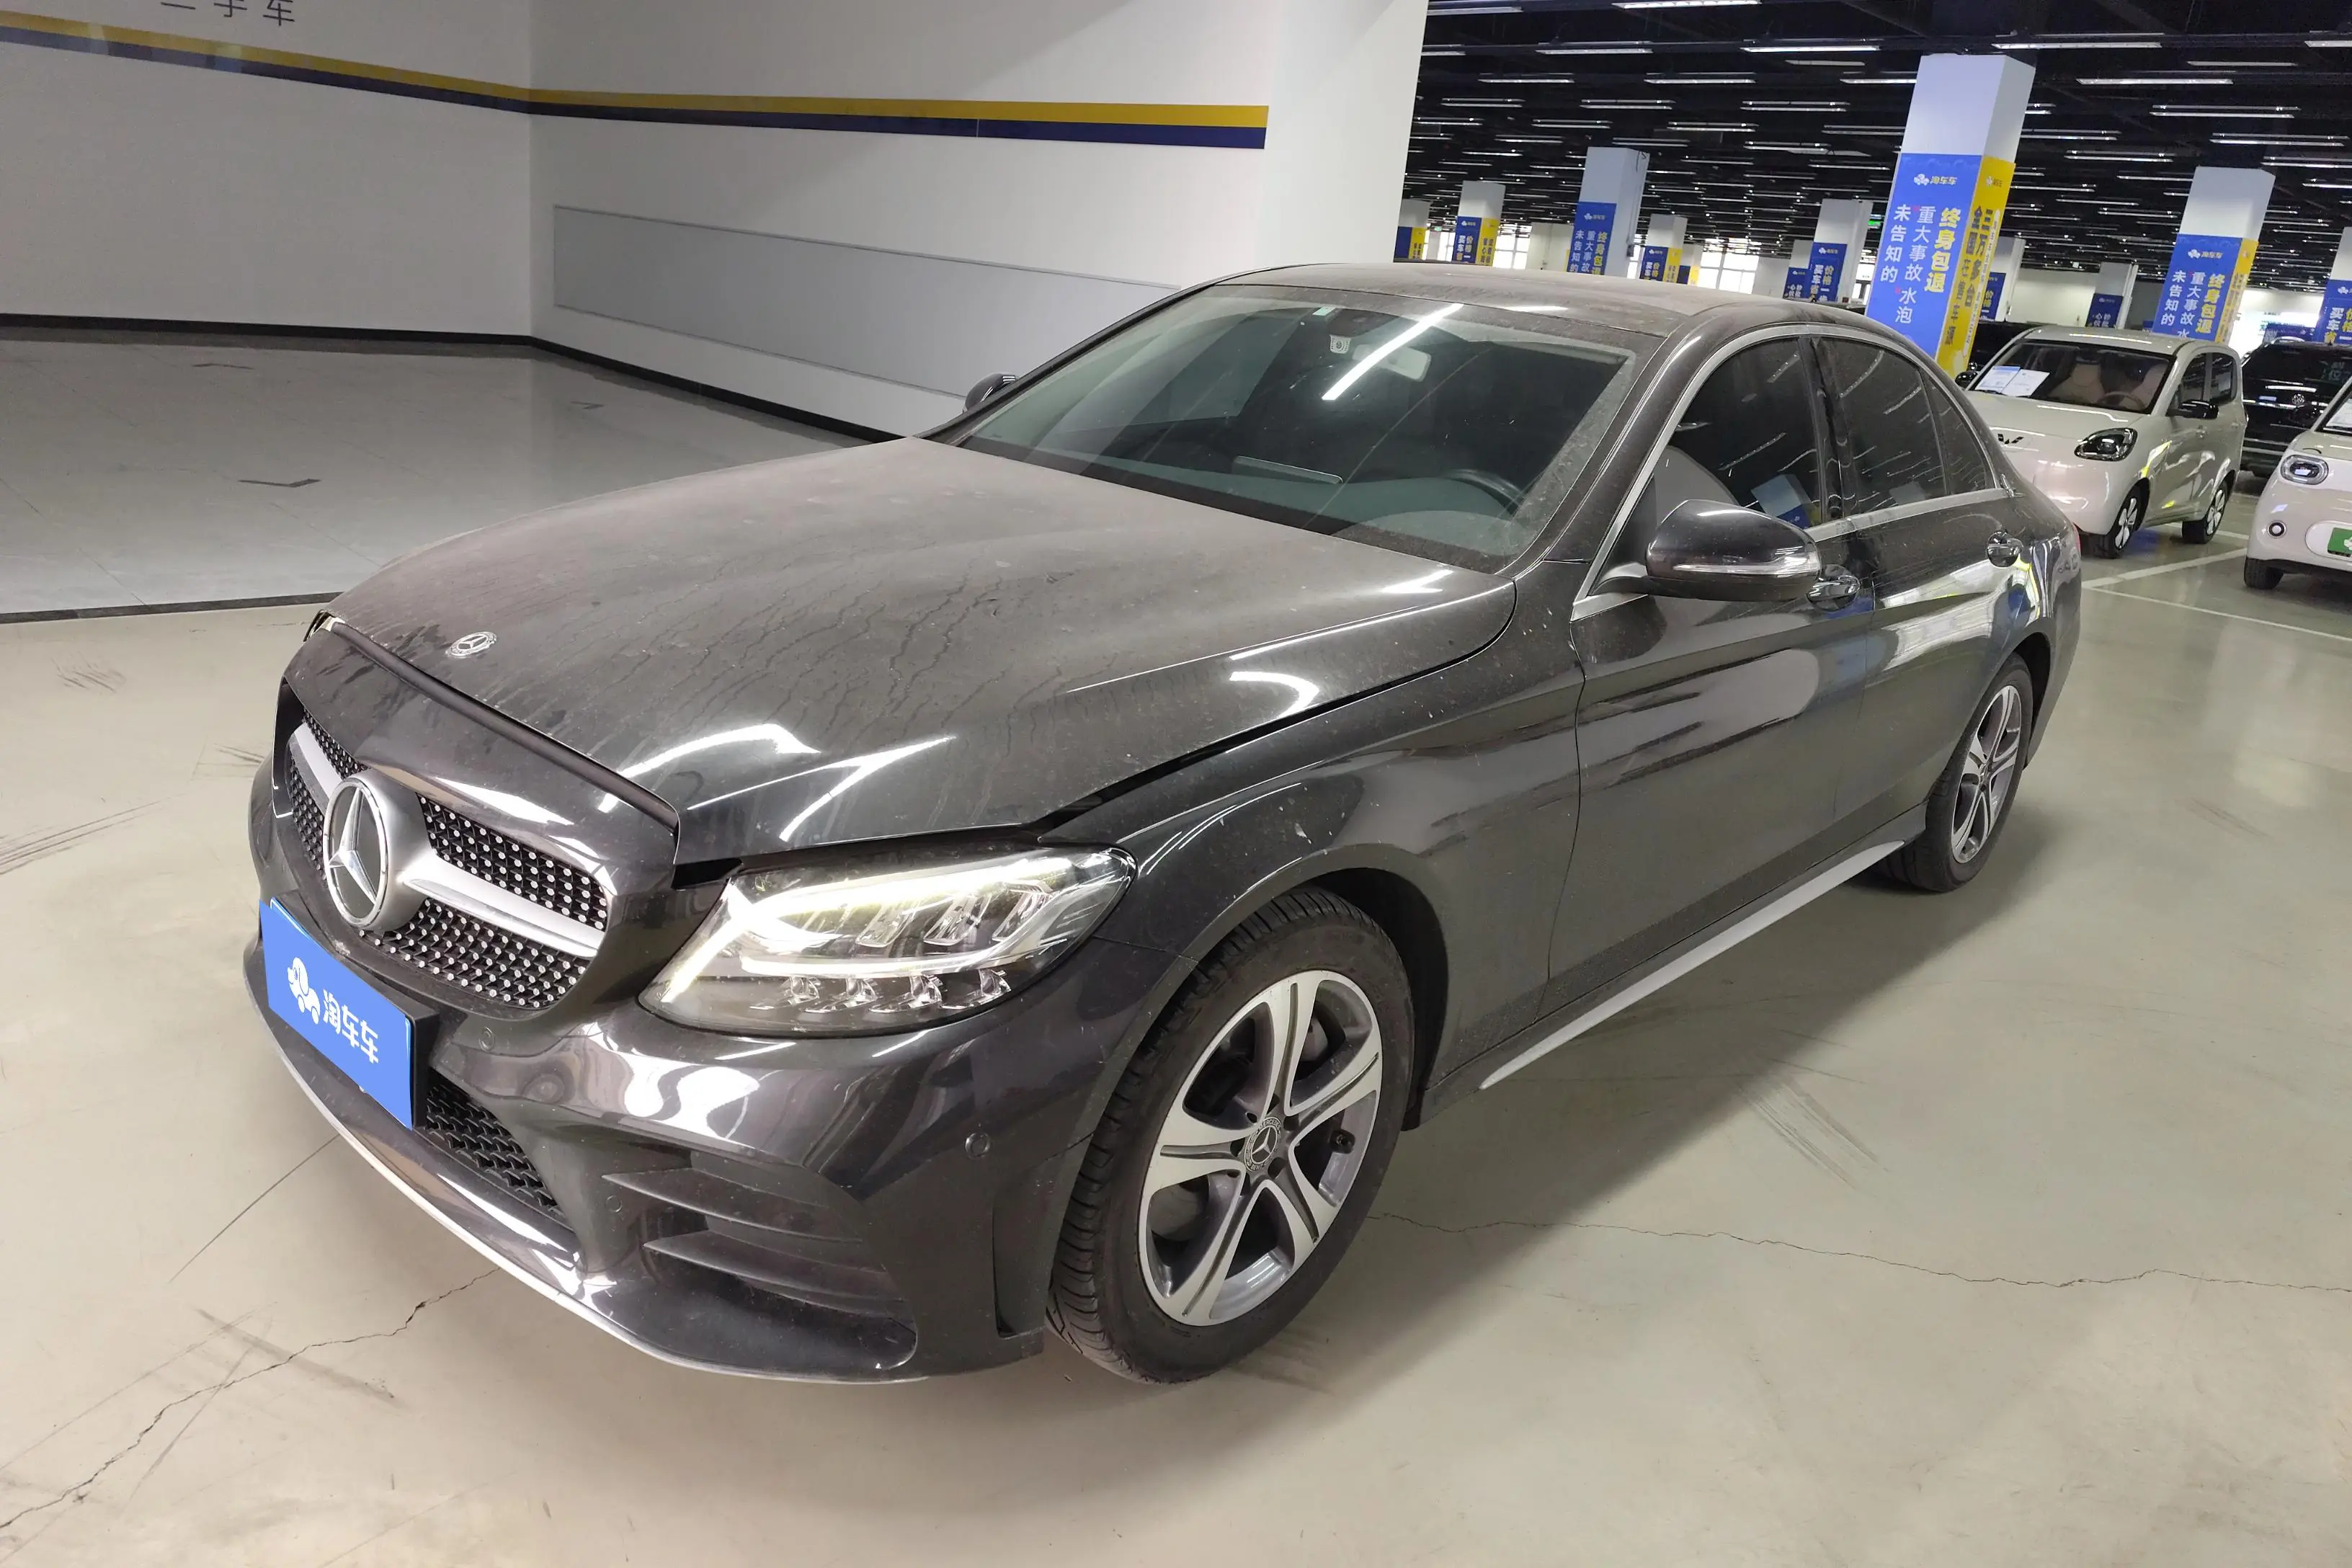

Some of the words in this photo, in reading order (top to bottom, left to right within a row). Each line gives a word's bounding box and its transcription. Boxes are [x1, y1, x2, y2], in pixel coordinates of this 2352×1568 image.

[1880, 204, 1912, 283] 未告知的
[1924, 207, 1961, 293] 终身包退
[2160, 270, 2186, 326] 未告知的
[2196, 273, 2225, 334] 终身包退
